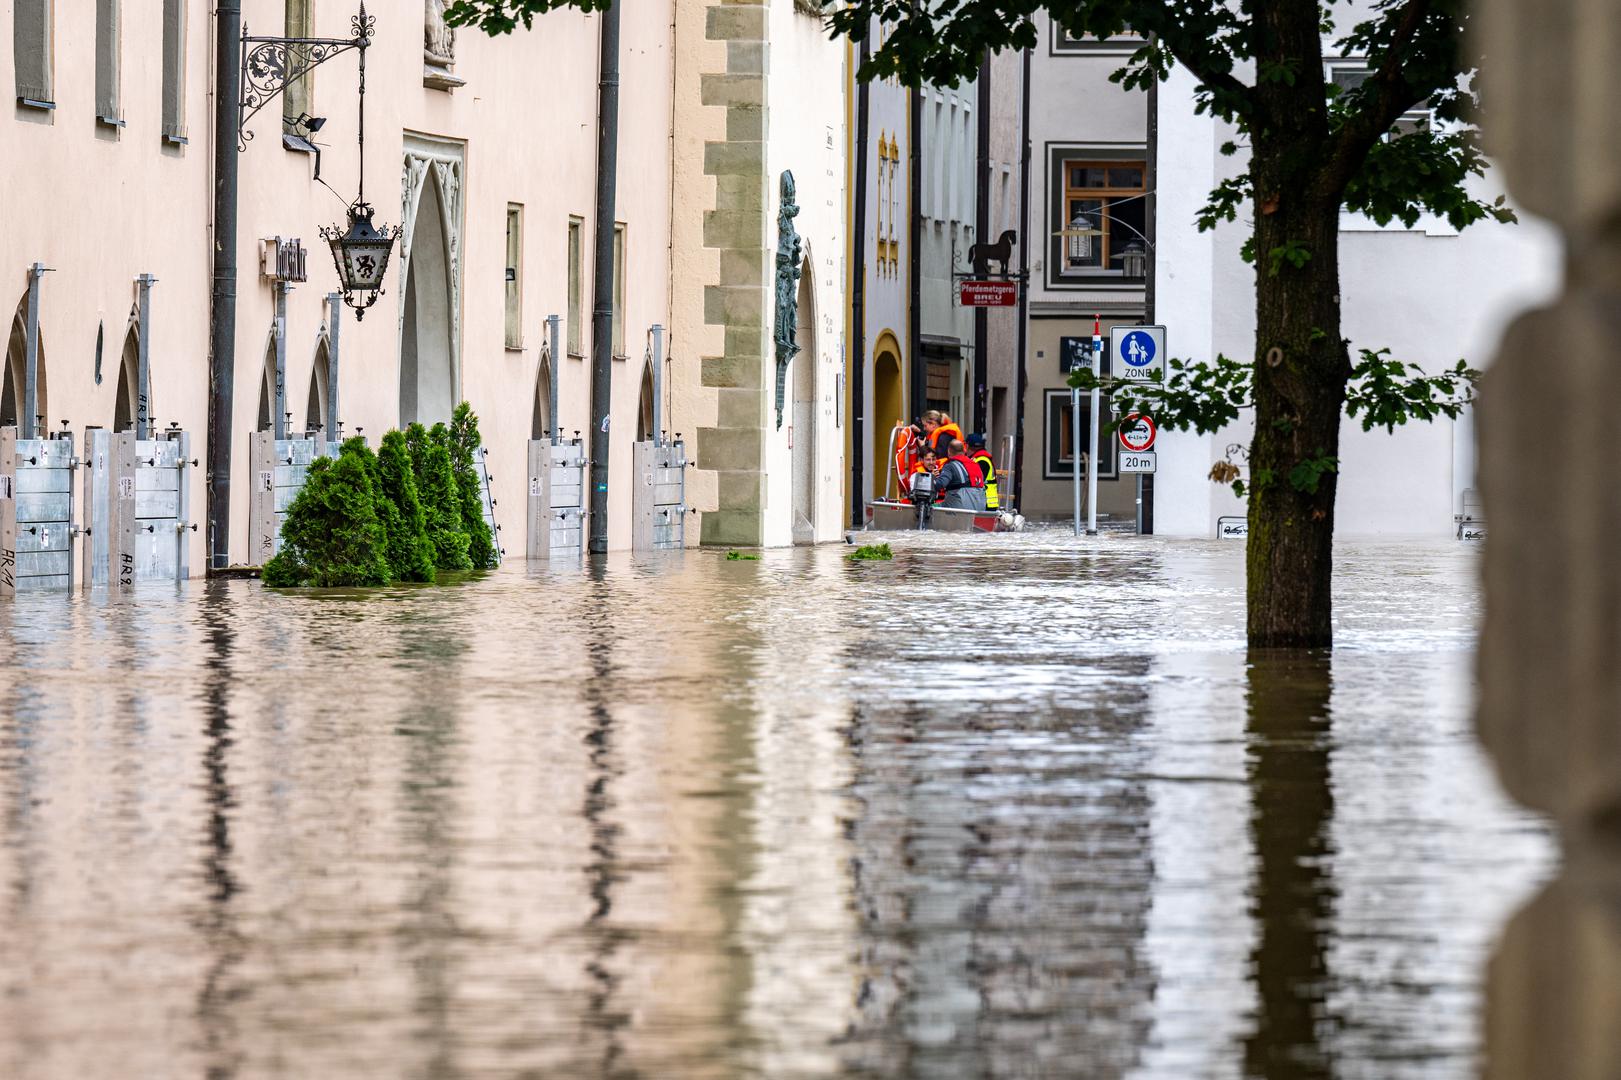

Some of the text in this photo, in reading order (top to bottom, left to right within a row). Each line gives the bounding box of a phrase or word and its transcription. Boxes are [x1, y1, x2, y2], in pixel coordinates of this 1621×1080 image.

[961, 284, 1015, 294] Pferdemetzgerei
[1125, 457, 1151, 467] 20 m
[262, 534, 272, 549] AR
[121, 553, 133, 576] AR
